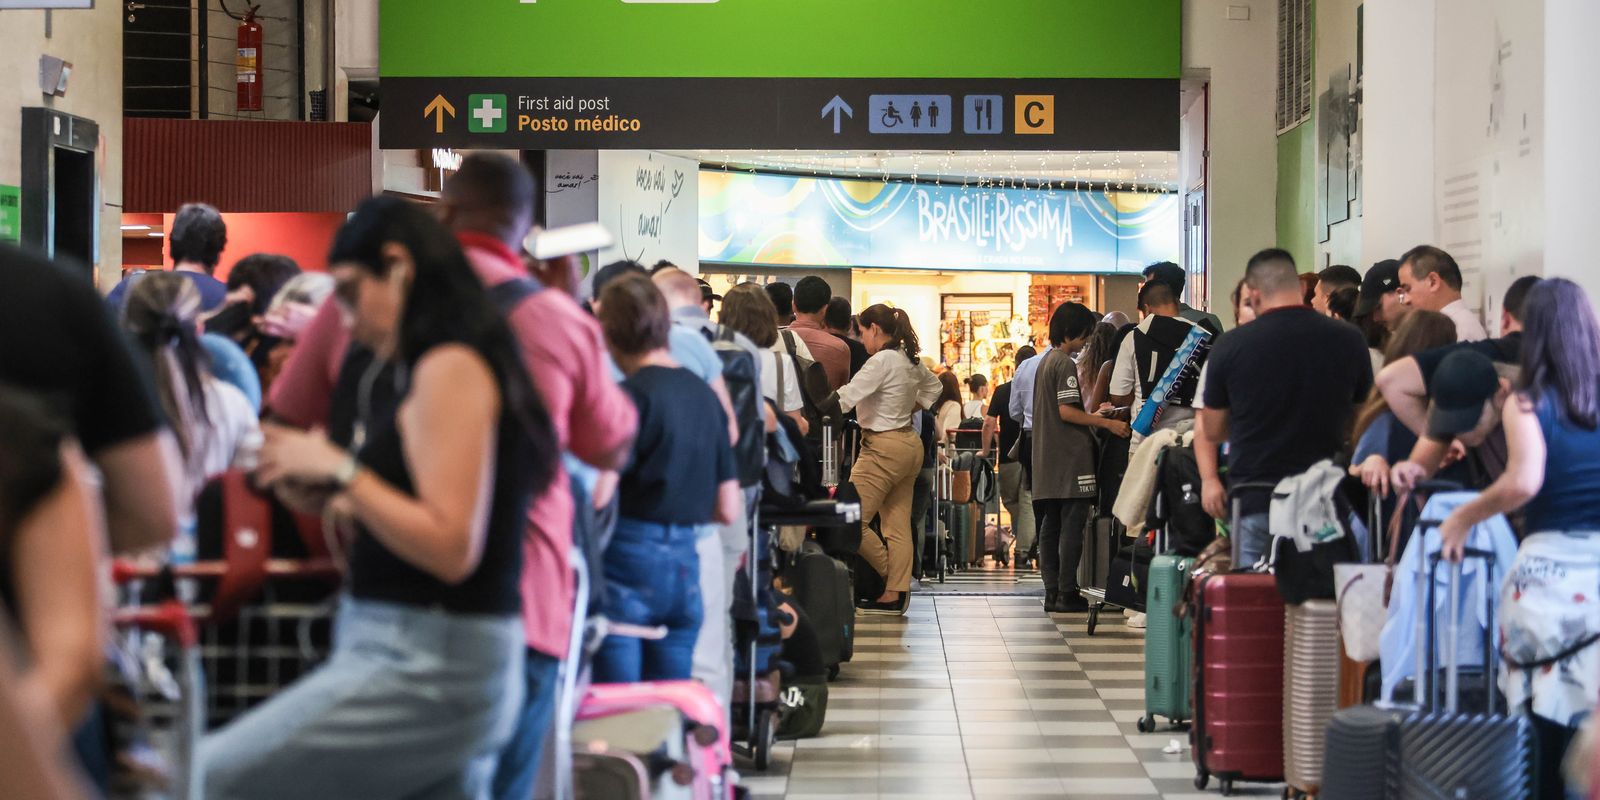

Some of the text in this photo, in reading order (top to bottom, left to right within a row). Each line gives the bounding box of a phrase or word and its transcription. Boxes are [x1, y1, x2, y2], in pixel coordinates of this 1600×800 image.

[518, 96, 610, 112] First aid post
[1024, 101, 1044, 128] C
[518, 115, 641, 131] Posto médico
